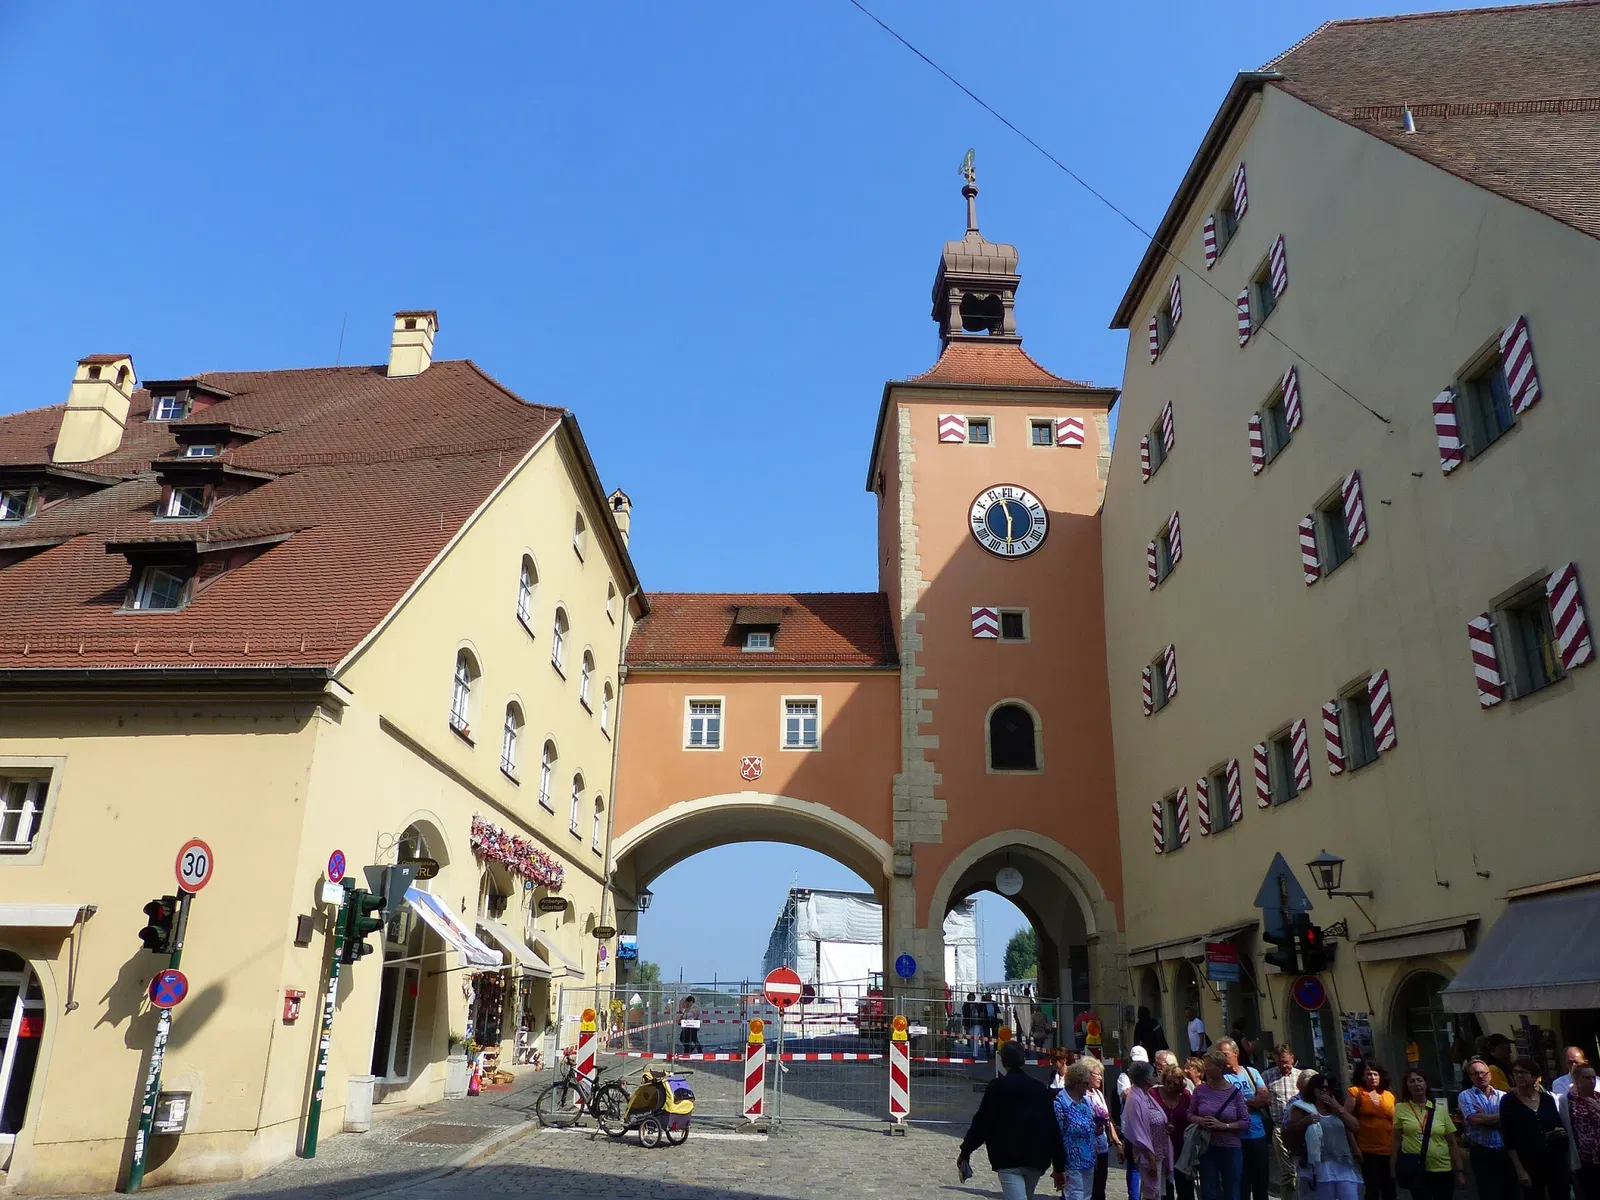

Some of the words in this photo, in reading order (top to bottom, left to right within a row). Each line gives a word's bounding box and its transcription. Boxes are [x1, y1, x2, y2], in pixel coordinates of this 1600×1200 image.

[1020, 492, 1025, 501] I
[1029, 503, 1039, 511] II
[183, 853, 206, 877] 30
